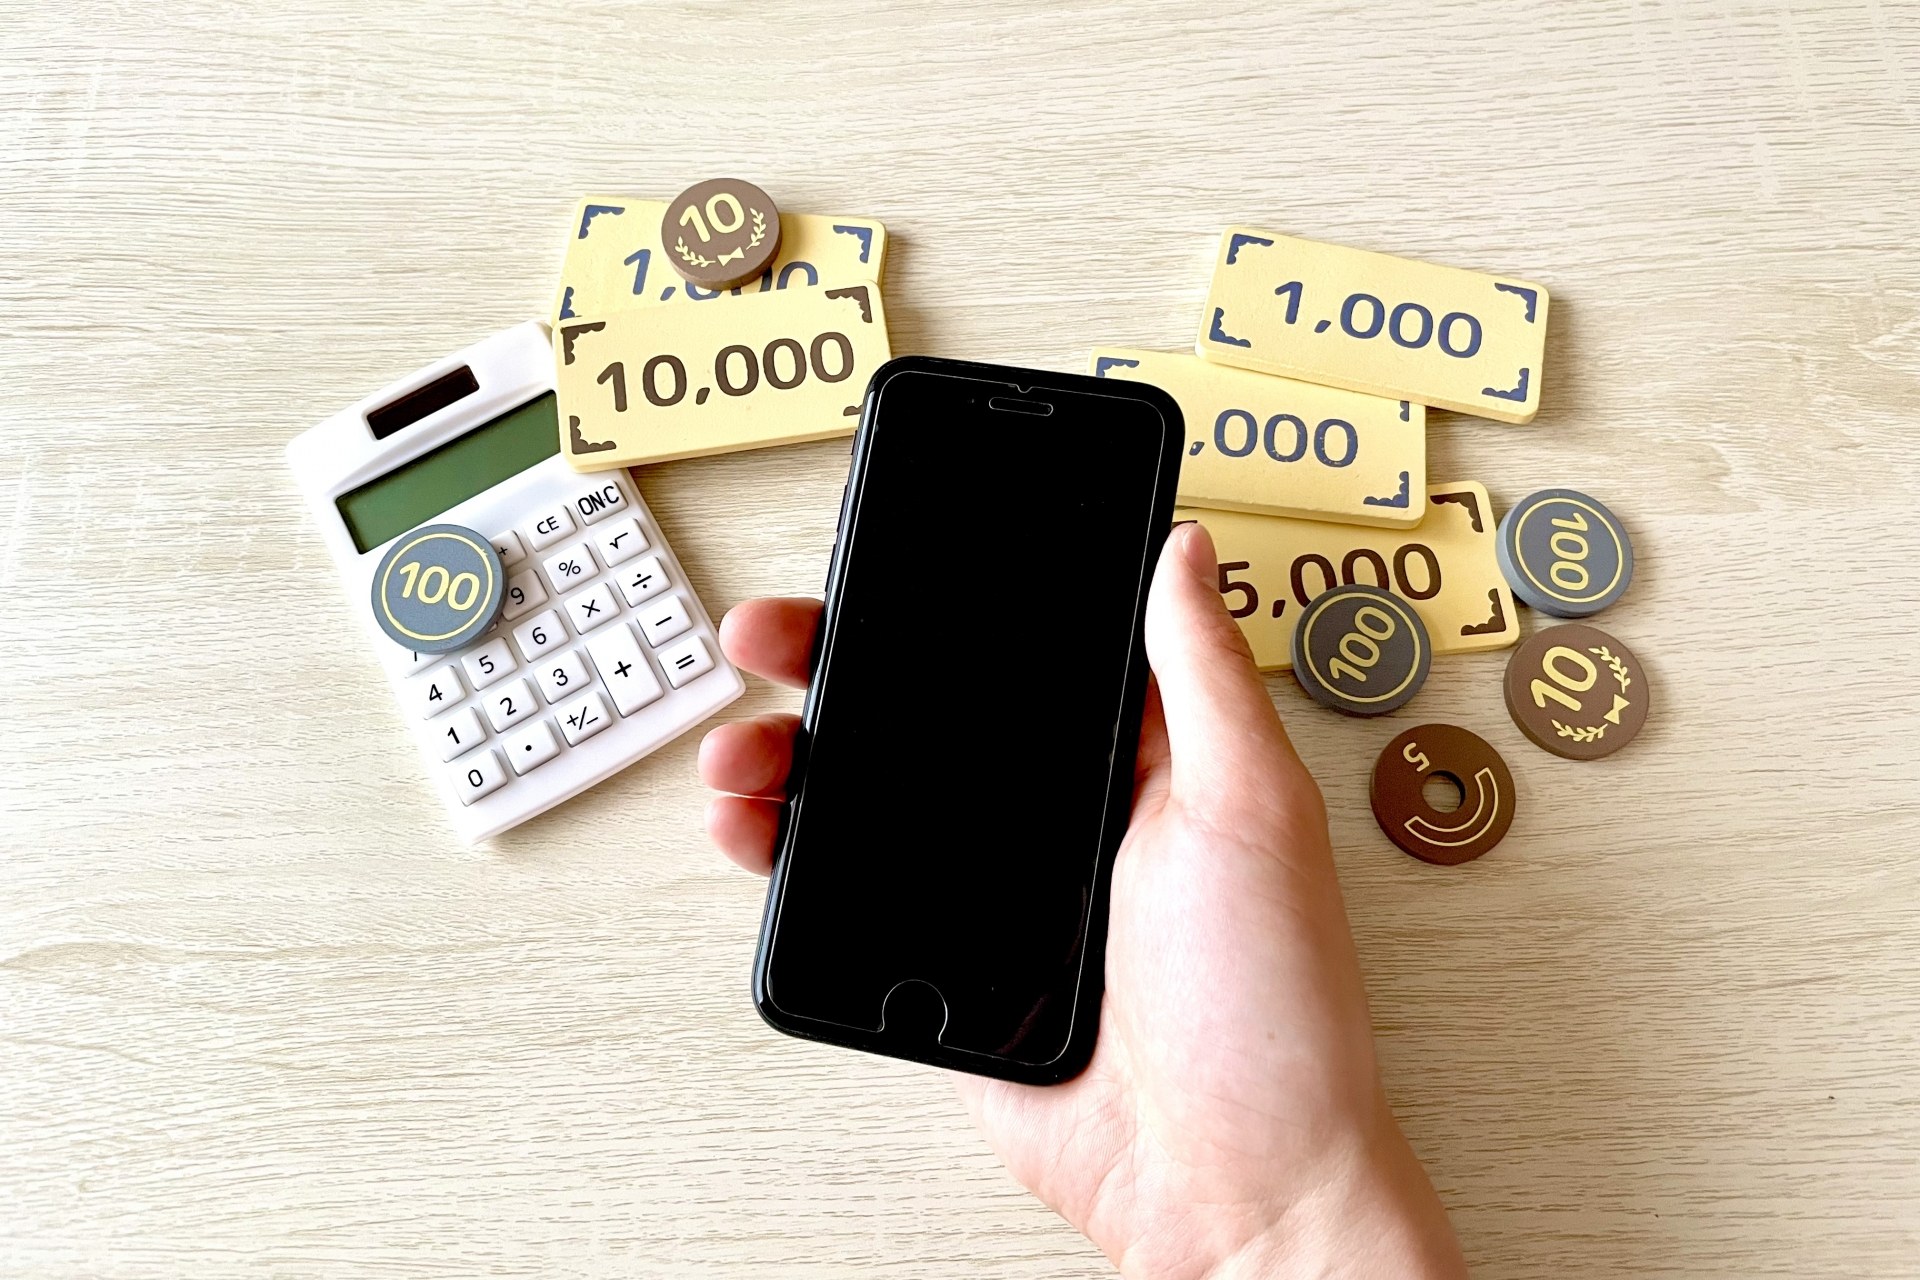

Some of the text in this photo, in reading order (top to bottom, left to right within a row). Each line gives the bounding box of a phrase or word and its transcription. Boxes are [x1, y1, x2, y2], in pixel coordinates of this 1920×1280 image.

[678, 192, 745, 243] 10
[1273, 280, 1484, 360] 1,000
[595, 330, 856, 414] 10,000
[536, 515, 560, 535] CE
[1549, 511, 1591, 592] 100
[558, 559, 582, 577] %
[398, 560, 481, 612] 100
[1216, 542, 1443, 619] 5,000
[509, 586, 526, 606] 9
[531, 626, 548, 646] 6
[1328, 605, 1397, 683] 100
[477, 654, 495, 674] 5
[552, 668, 569, 687] 3
[1530, 645, 1599, 713] 10
[428, 683, 443, 701] 4
[499, 696, 517, 716] 2
[446, 726, 461, 745] 1
[1402, 741, 1431, 773] 5
[467, 768, 485, 788] 0
